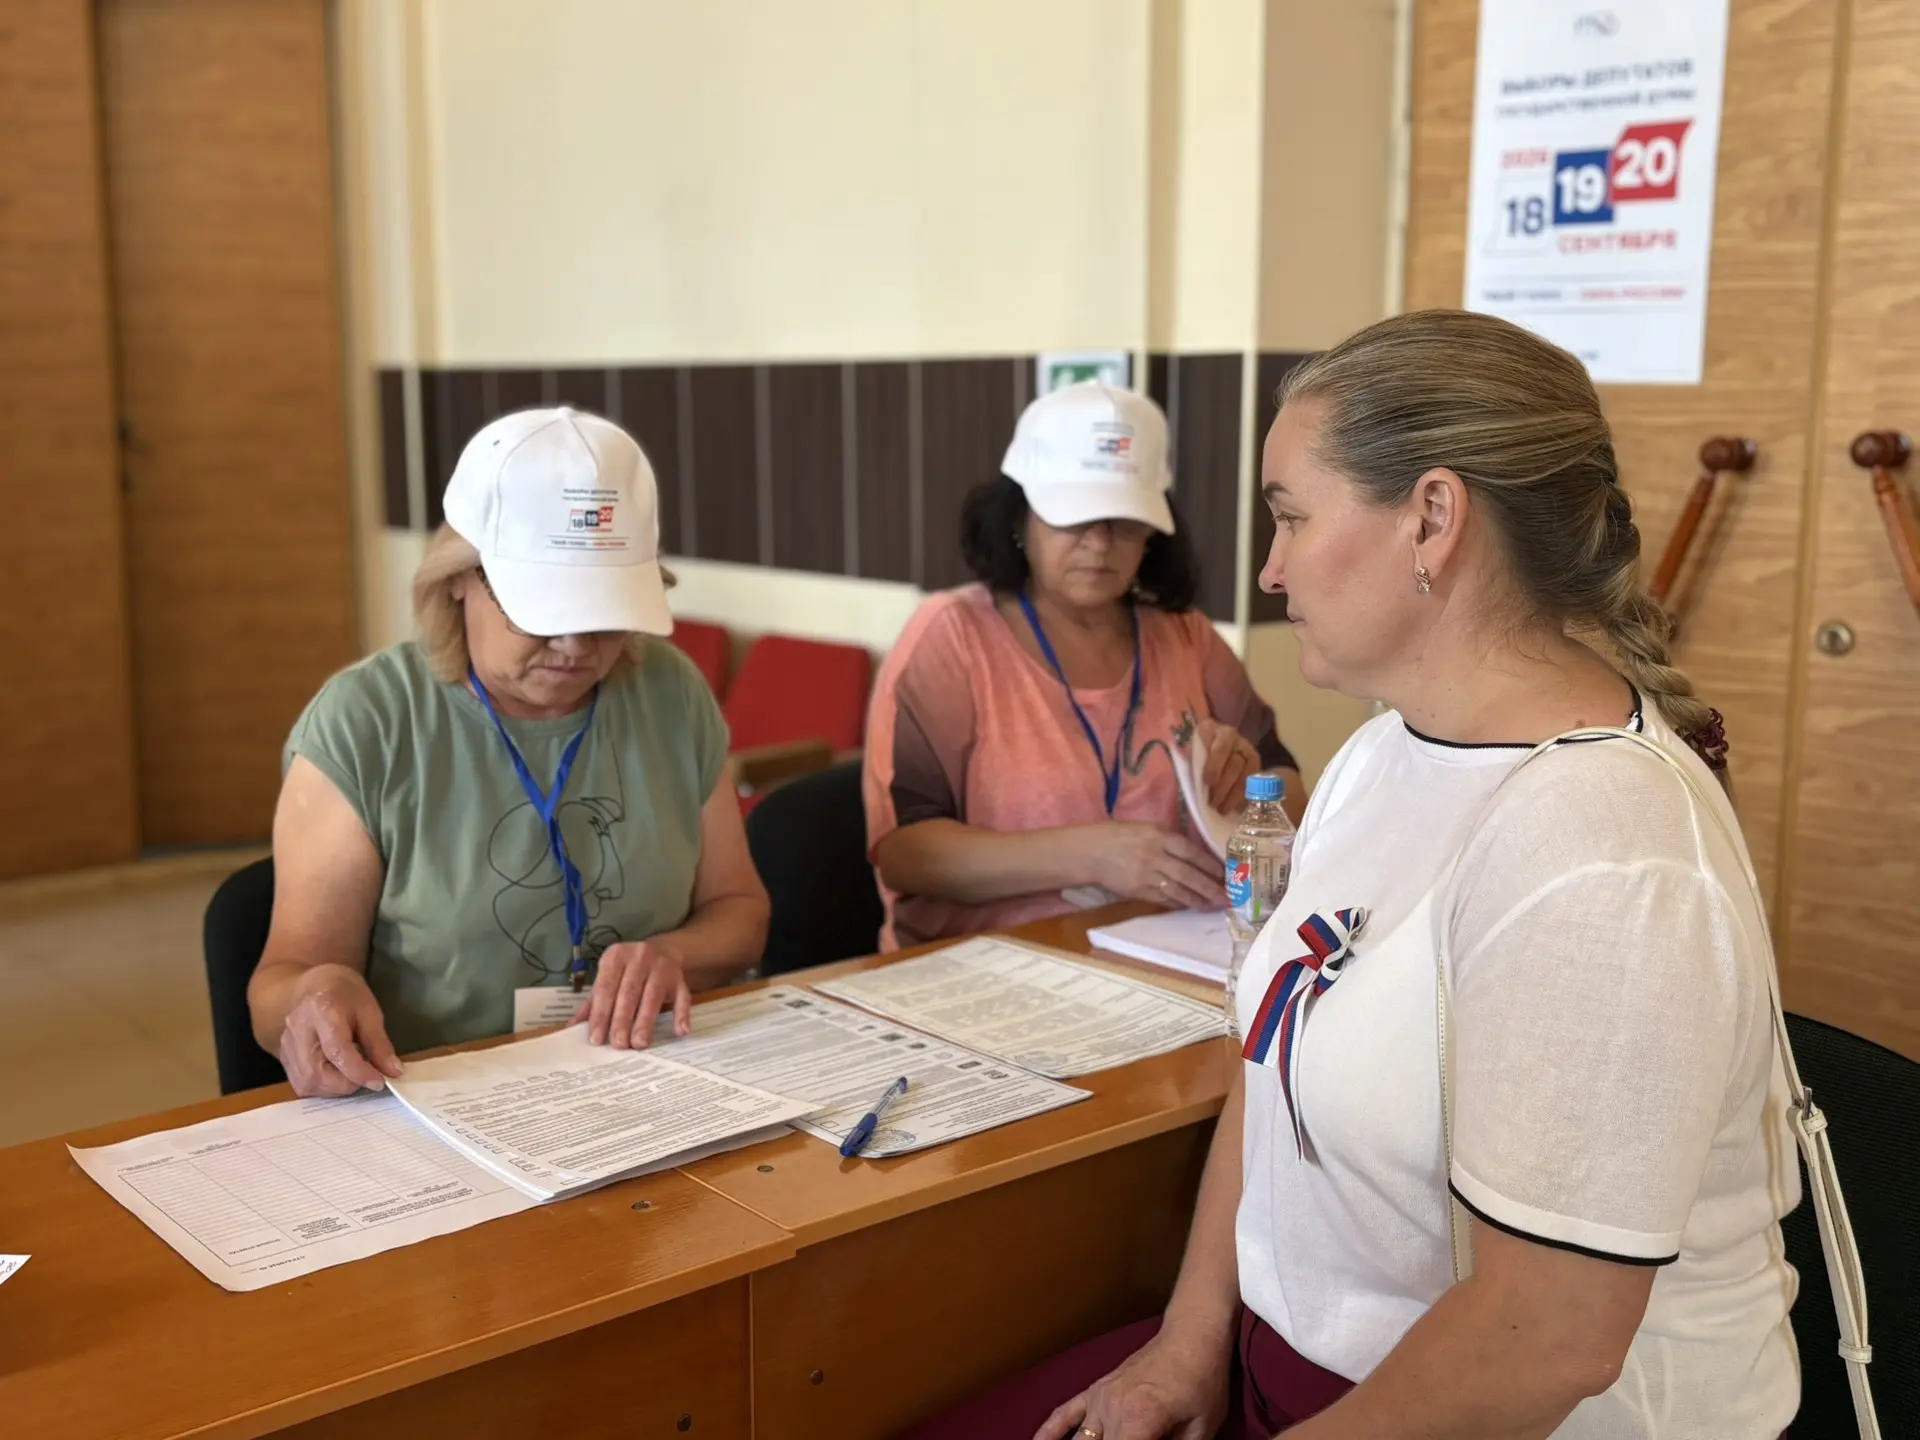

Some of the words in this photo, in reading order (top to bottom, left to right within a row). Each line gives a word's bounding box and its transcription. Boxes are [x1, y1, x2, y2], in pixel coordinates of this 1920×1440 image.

[1585, 59, 1693, 88] ДЕПУТАТОВ
[1504, 197, 1545, 237] 18
[1556, 164, 1608, 214] 19
[1611, 136, 1677, 188] 20
